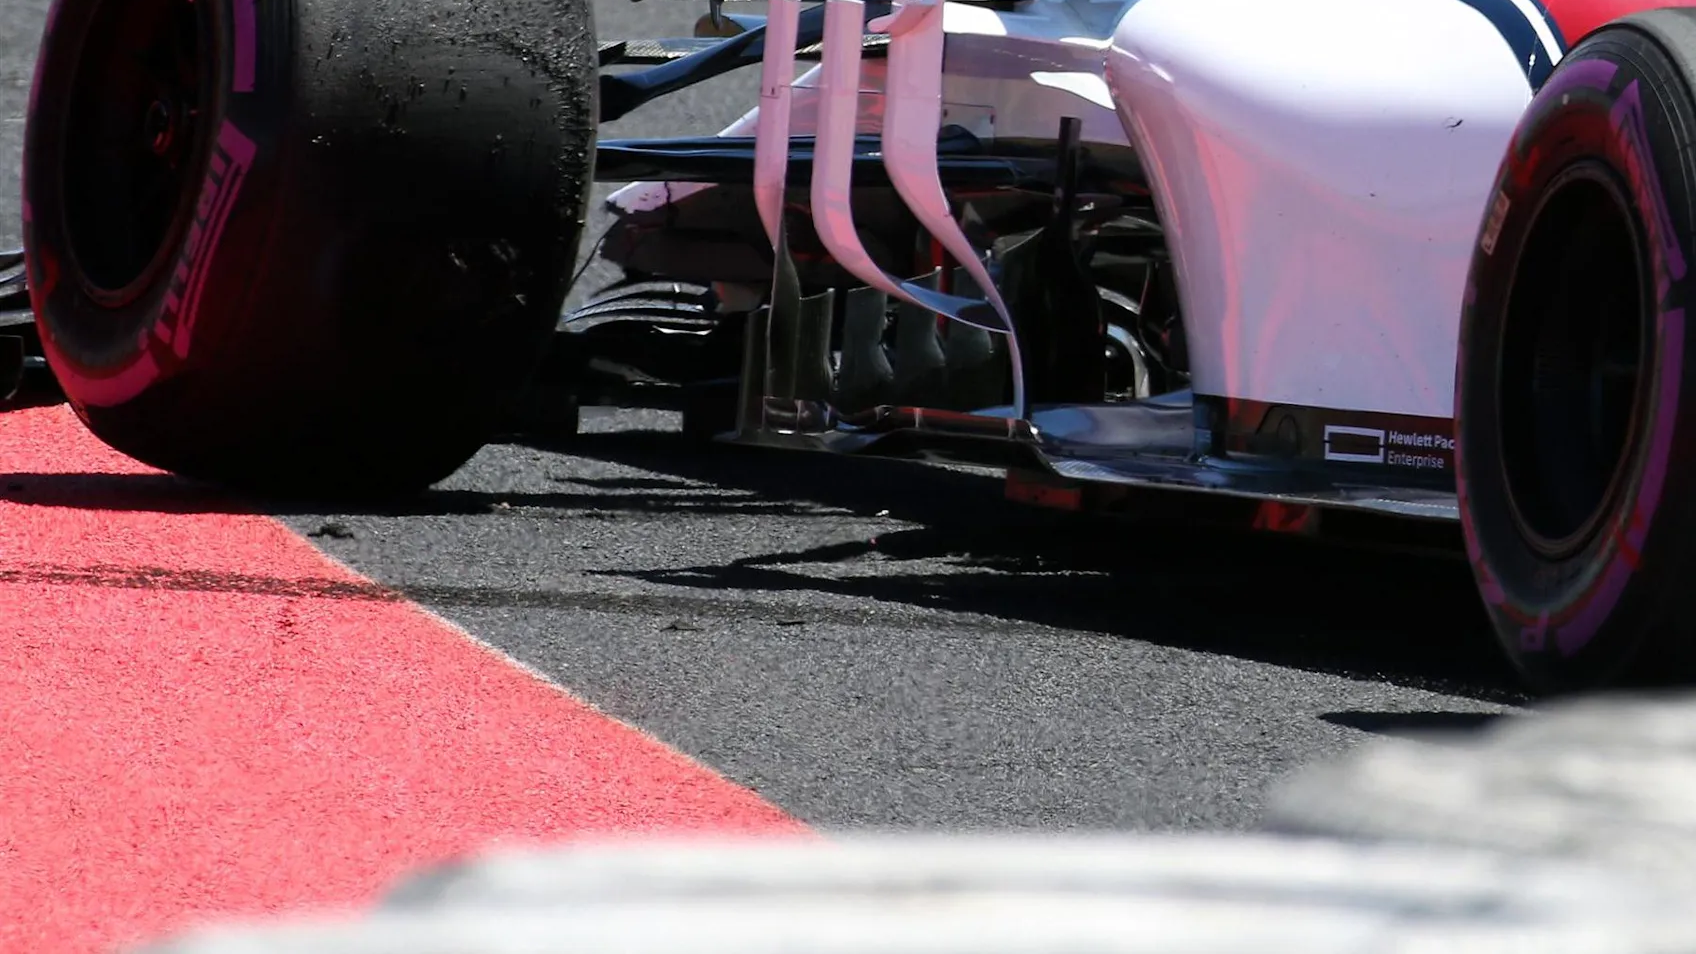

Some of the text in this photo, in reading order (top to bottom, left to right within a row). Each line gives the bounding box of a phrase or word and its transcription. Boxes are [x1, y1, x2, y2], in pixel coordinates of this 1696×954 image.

[1388, 431, 1456, 450] Hewlett Pac
[1387, 450, 1445, 469] Enterprise
